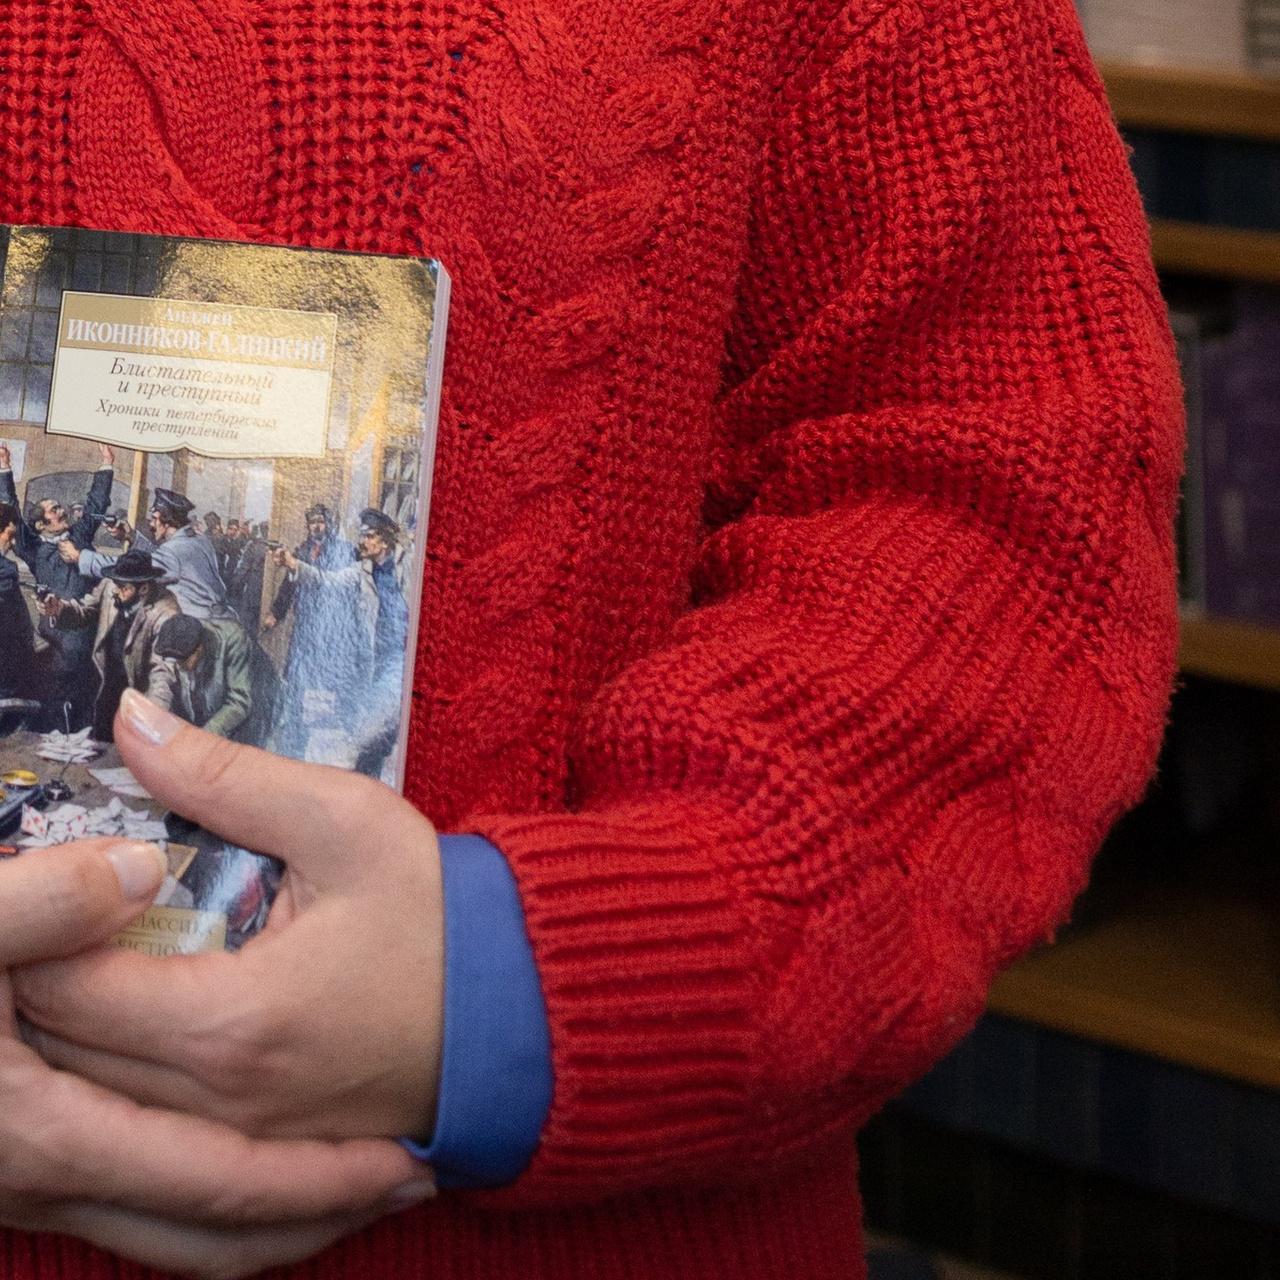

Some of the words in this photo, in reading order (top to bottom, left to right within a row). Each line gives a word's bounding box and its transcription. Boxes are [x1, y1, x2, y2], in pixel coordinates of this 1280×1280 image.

[66, 318, 326, 363] ИКОННИКОВ-ГАЛИЦКИЙ
[110, 357, 275, 391] Блистательный
[117, 380, 130, 393] и
[136, 382, 262, 405] преступный
[96, 398, 160, 417] Хроники
[165, 407, 278, 429] петербургских
